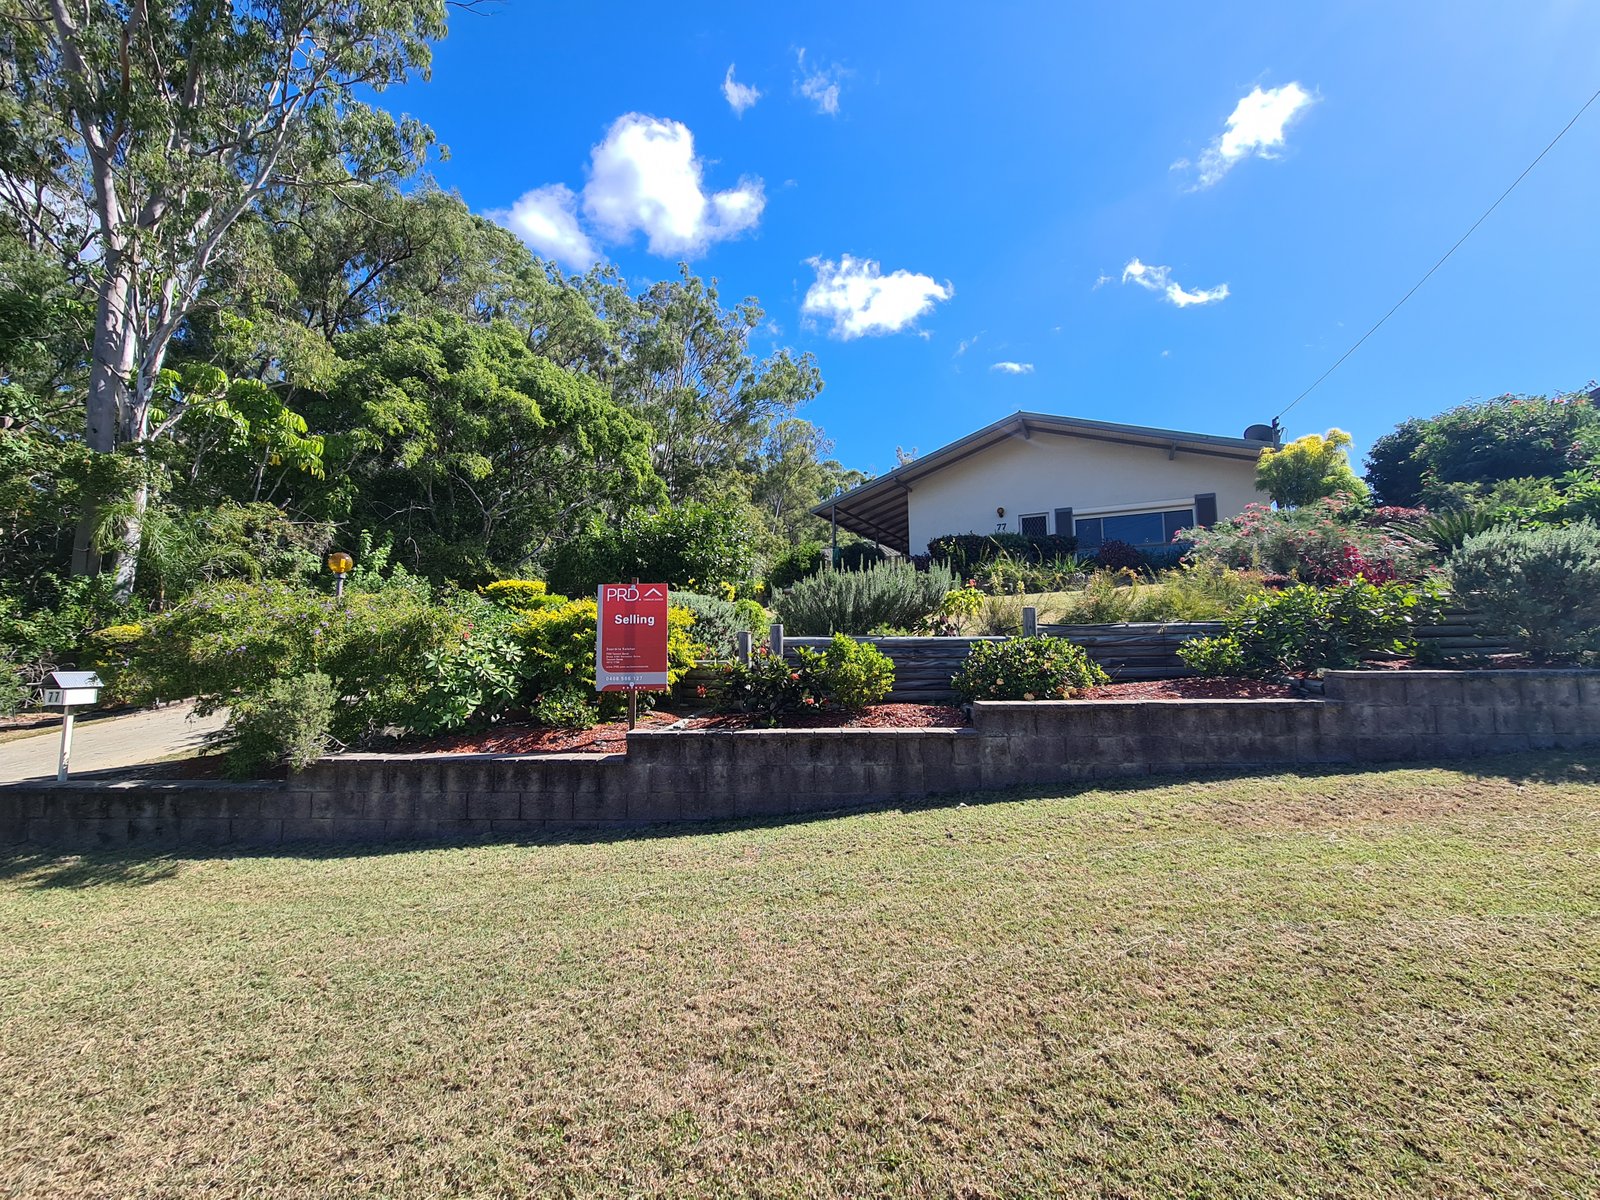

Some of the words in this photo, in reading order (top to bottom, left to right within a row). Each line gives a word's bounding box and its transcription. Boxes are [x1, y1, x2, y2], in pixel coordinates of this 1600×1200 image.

[997, 523, 1007, 531] 77
[614, 614, 655, 626] Selling
[48, 691, 60, 703] 77
